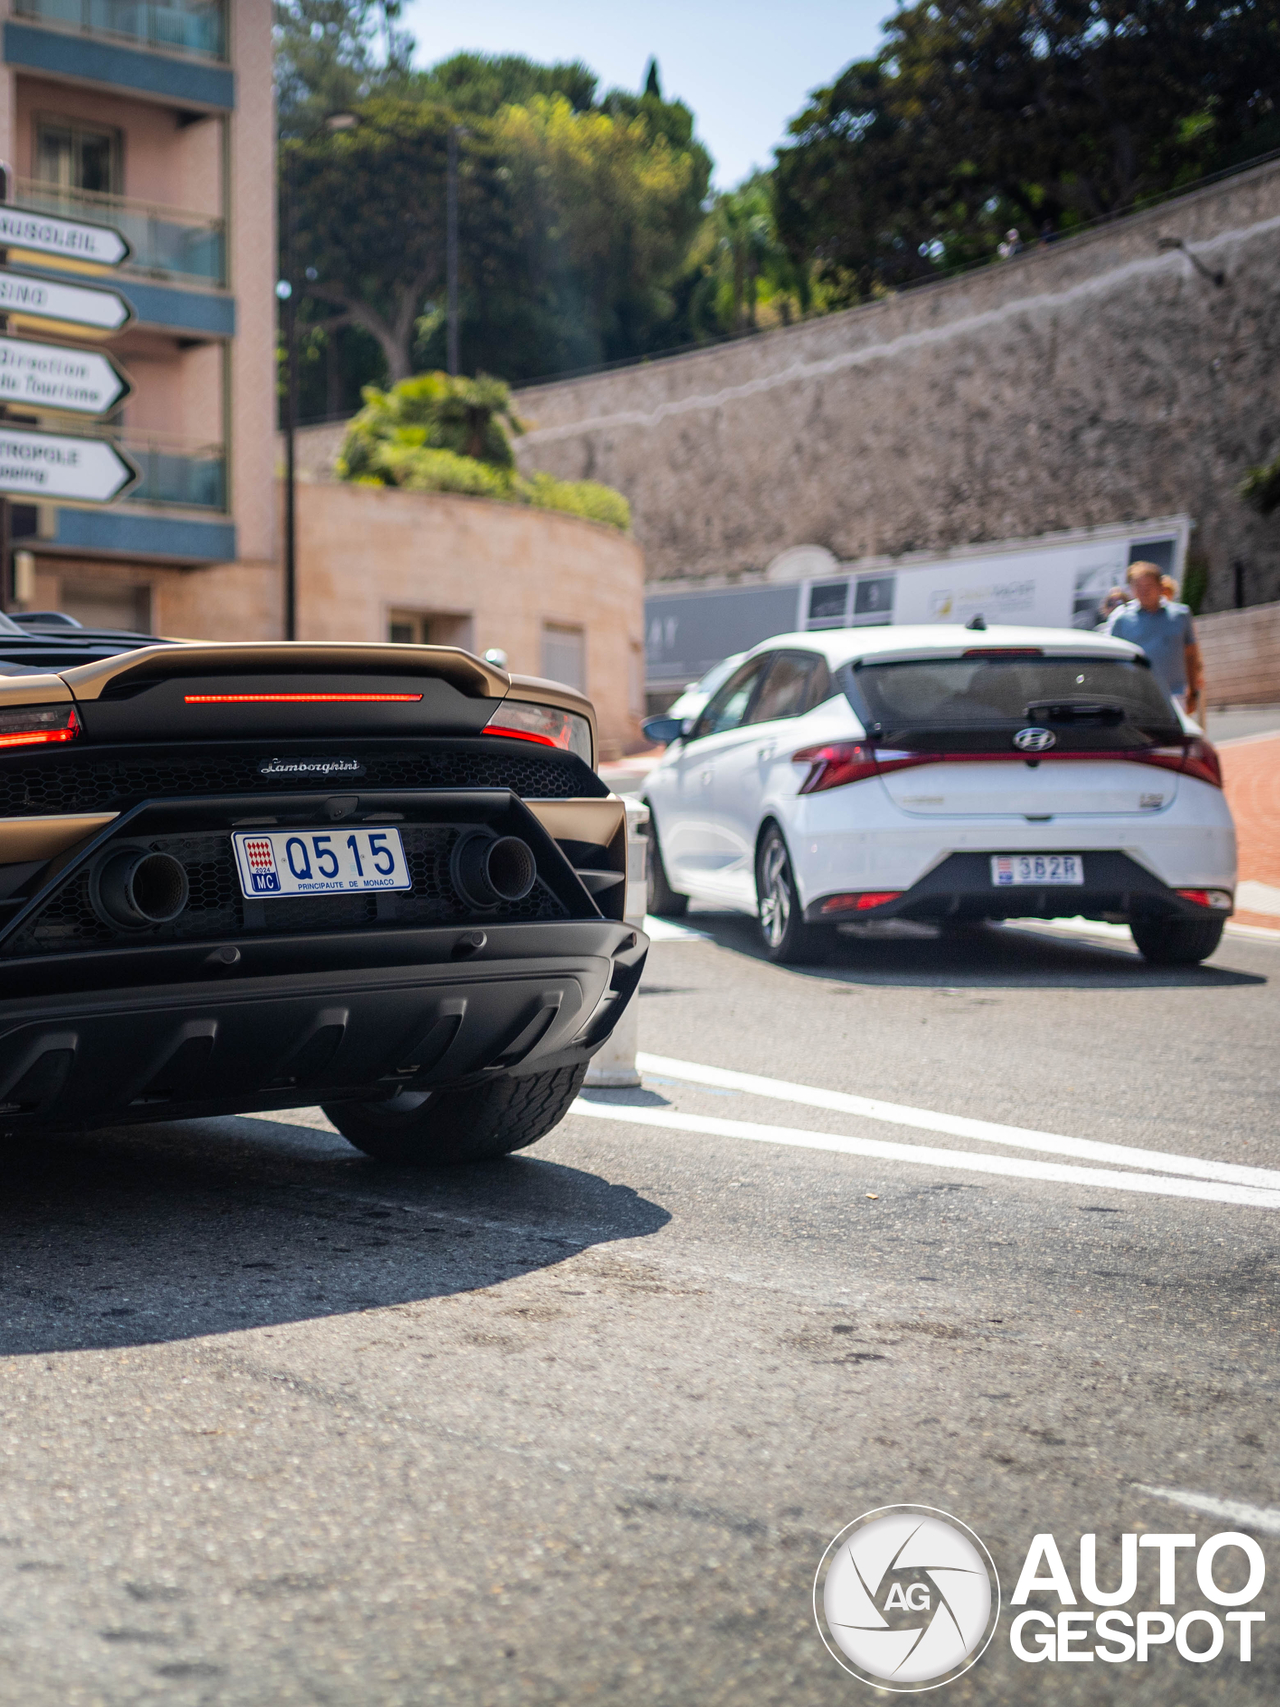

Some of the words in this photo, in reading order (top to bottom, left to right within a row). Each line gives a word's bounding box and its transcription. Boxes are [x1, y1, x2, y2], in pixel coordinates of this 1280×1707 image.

[261, 758, 360, 774] Lamborghini
[286, 834, 395, 880] Q515
[256, 875, 274, 889] MC
[298, 881, 344, 890] PRINCIPAUTE
[349, 880, 358, 888] DE
[363, 879, 395, 887] MONACO
